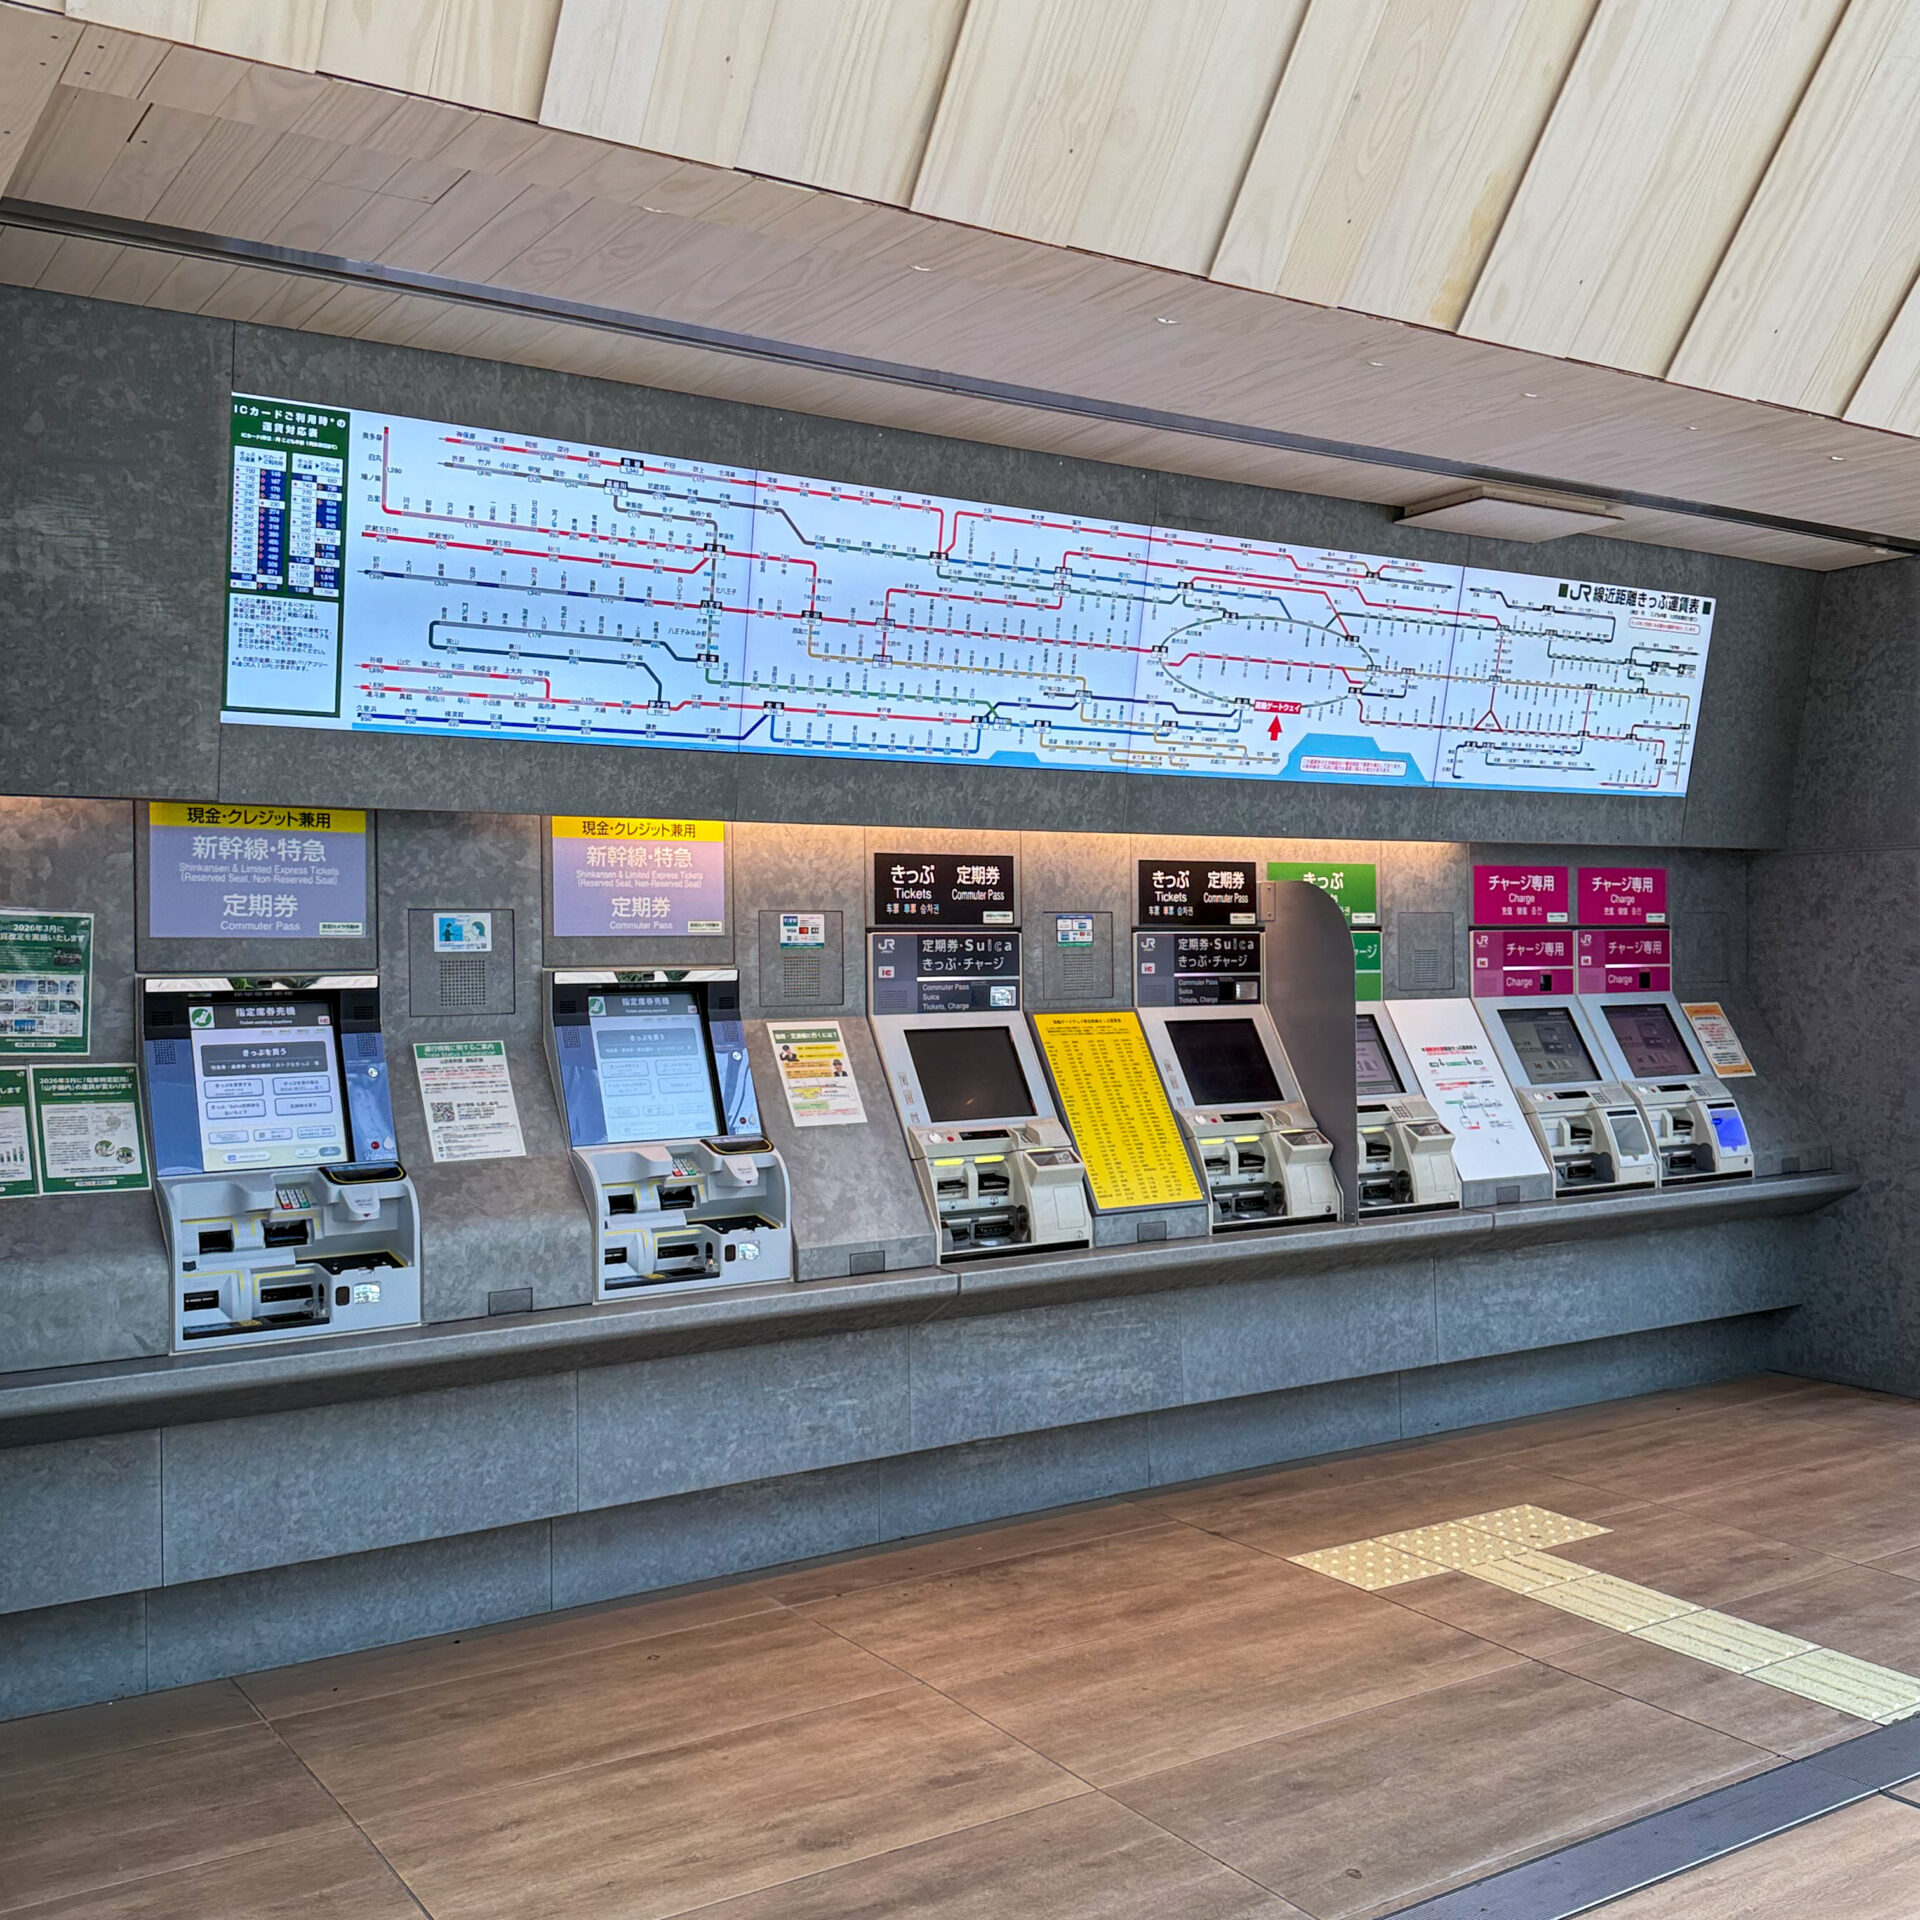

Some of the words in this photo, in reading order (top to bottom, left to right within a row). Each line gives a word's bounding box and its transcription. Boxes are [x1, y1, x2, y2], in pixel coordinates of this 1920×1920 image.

[187, 808, 331, 829] 現金・クレジット兼用
[582, 821, 696, 838] 現金・クレジット兼用
[192, 835, 326, 862] 新幹線・特急
[587, 845, 693, 868] 新幹線・特急
[179, 862, 230, 873] Shinkansen
[232, 864, 239, 873] &
[241, 864, 273, 874] Limited
[274, 866, 308, 877] Express
[310, 865, 340, 876] Tickets
[576, 870, 617, 879] Shinkansen
[618, 871, 624, 879] &
[625, 870, 650, 879] Limited
[651, 871, 679, 881] Express
[680, 871, 703, 880] Tickets
[891, 865, 935, 884] きっぷ
[956, 865, 1000, 886] 定期券
[1152, 870, 1190, 889] きっぷ
[1207, 870, 1245, 890] 定期券
[1303, 871, 1344, 889] きっぷ
[1489, 875, 1555, 892] チャージ専用
[1592, 877, 1654, 893] チャージ専用
[894, 887, 932, 900] Tickets
[951, 889, 986, 901] Commuter
[987, 890, 1005, 901] Pass
[1155, 891, 1188, 903] Tickets
[1203, 892, 1233, 904] Commuter
[1233, 893, 1249, 904] Pass
[1508, 893, 1535, 905] Charge
[1610, 893, 1635, 905] Charge
[223, 894, 299, 918] 定期券
[611, 896, 671, 918] 定期券
[13, 924, 65, 933] 2026年3月に
[220, 921, 273, 931] Commuter
[275, 921, 300, 931] Pass
[609, 921, 651, 930] Commuter
[653, 921, 673, 930] Pass
[878, 938, 895, 950] JR
[1141, 938, 1156, 949] JR
[1476, 935, 1488, 945] JR
[1581, 934, 1592, 944] JR
[1506, 942, 1565, 956] チャージ専用
[1608, 941, 1662, 955] チャージ専用
[922, 956, 1004, 971] きっぷ・チャージ
[1178, 955, 1248, 968] きっぷ・チャージ
[1506, 977, 1533, 989] Charge
[1607, 974, 1633, 985] Charge
[1200, 996, 1218, 1004] Charge
[947, 1003, 970, 1011] Charge
